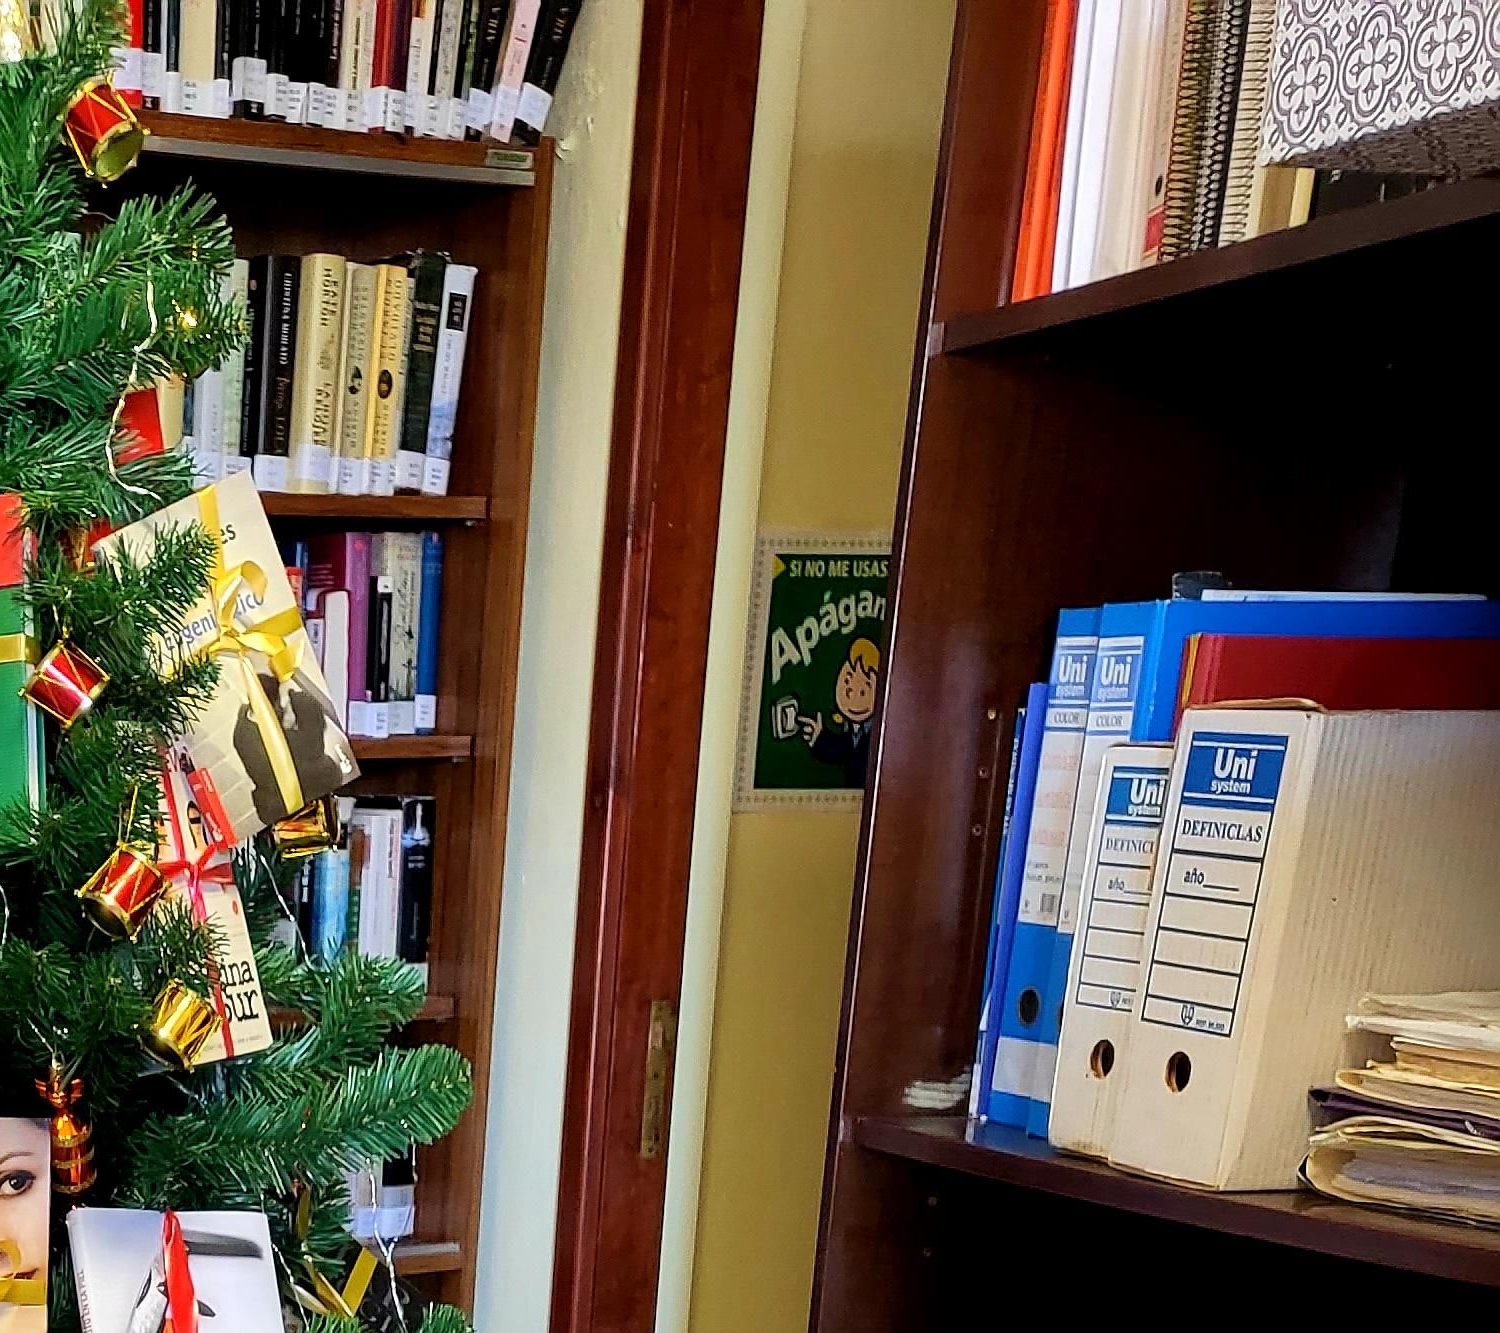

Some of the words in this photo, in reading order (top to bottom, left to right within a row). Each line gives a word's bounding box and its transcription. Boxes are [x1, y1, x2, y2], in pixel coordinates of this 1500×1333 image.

[789, 560, 800, 577] SI
[805, 560, 825, 577] NO
[828, 560, 850, 577] ME
[853, 560, 889, 577] USAS
[1059, 656, 1087, 683] Uni
[1101, 657, 1131, 685] Uni
[1054, 712, 1080, 724] COLOR
[1096, 716, 1123, 726] COLOR
[1214, 747, 1258, 780] Uni
[1130, 778, 1165, 805] Uni
[1211, 780, 1250, 794] system
[1128, 804, 1160, 816] system
[1182, 818, 1263, 842] DEFINICLAS
